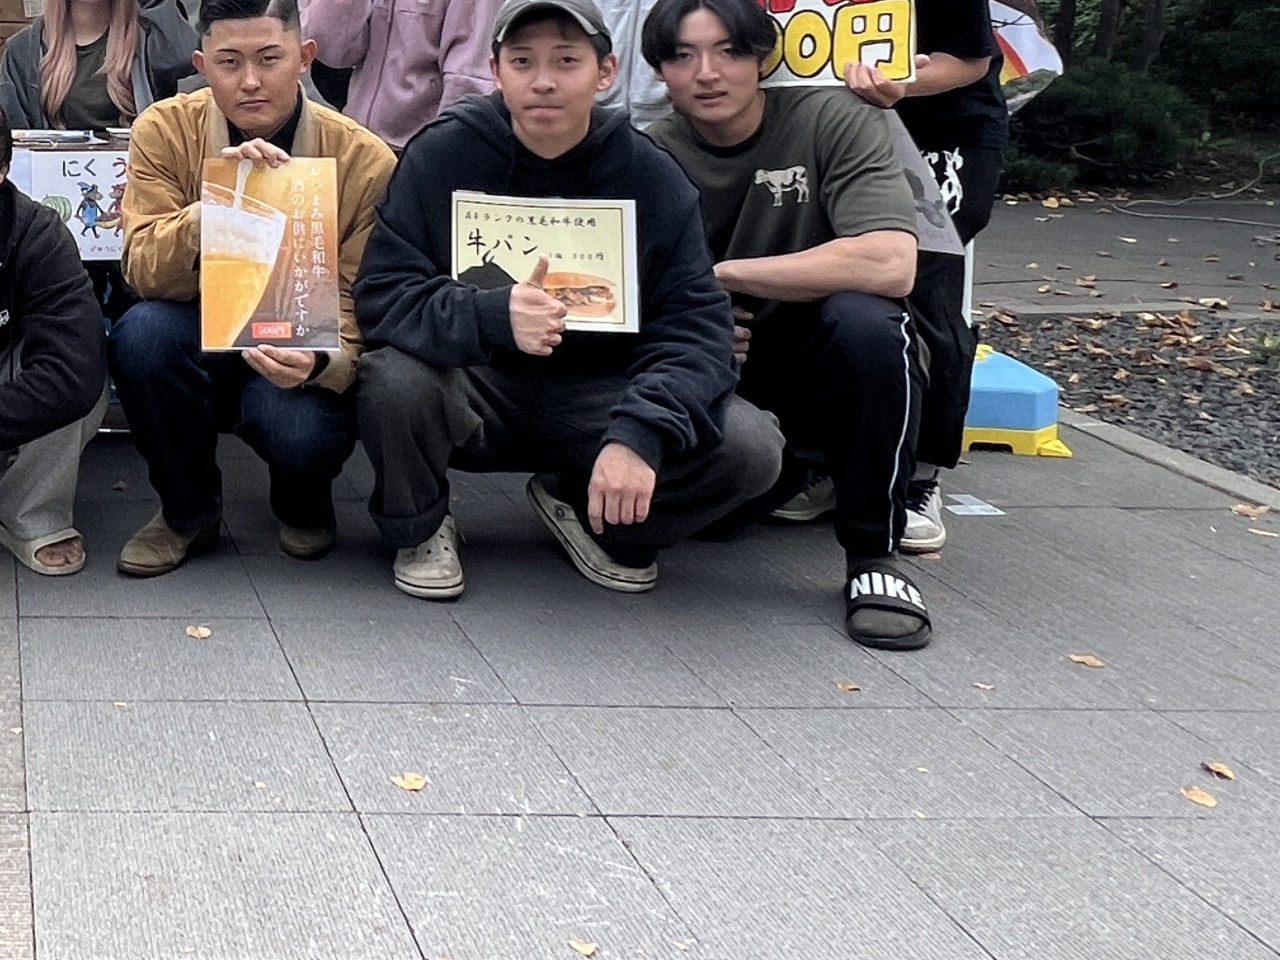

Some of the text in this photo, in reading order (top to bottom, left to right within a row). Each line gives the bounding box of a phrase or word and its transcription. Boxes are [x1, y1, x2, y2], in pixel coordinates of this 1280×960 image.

[62, 158, 97, 178] にく
[308, 166, 327, 279] おつまみ黒毛和牛
[466, 227, 538, 256] 牛パン
[850, 571, 926, 611] NIKE
